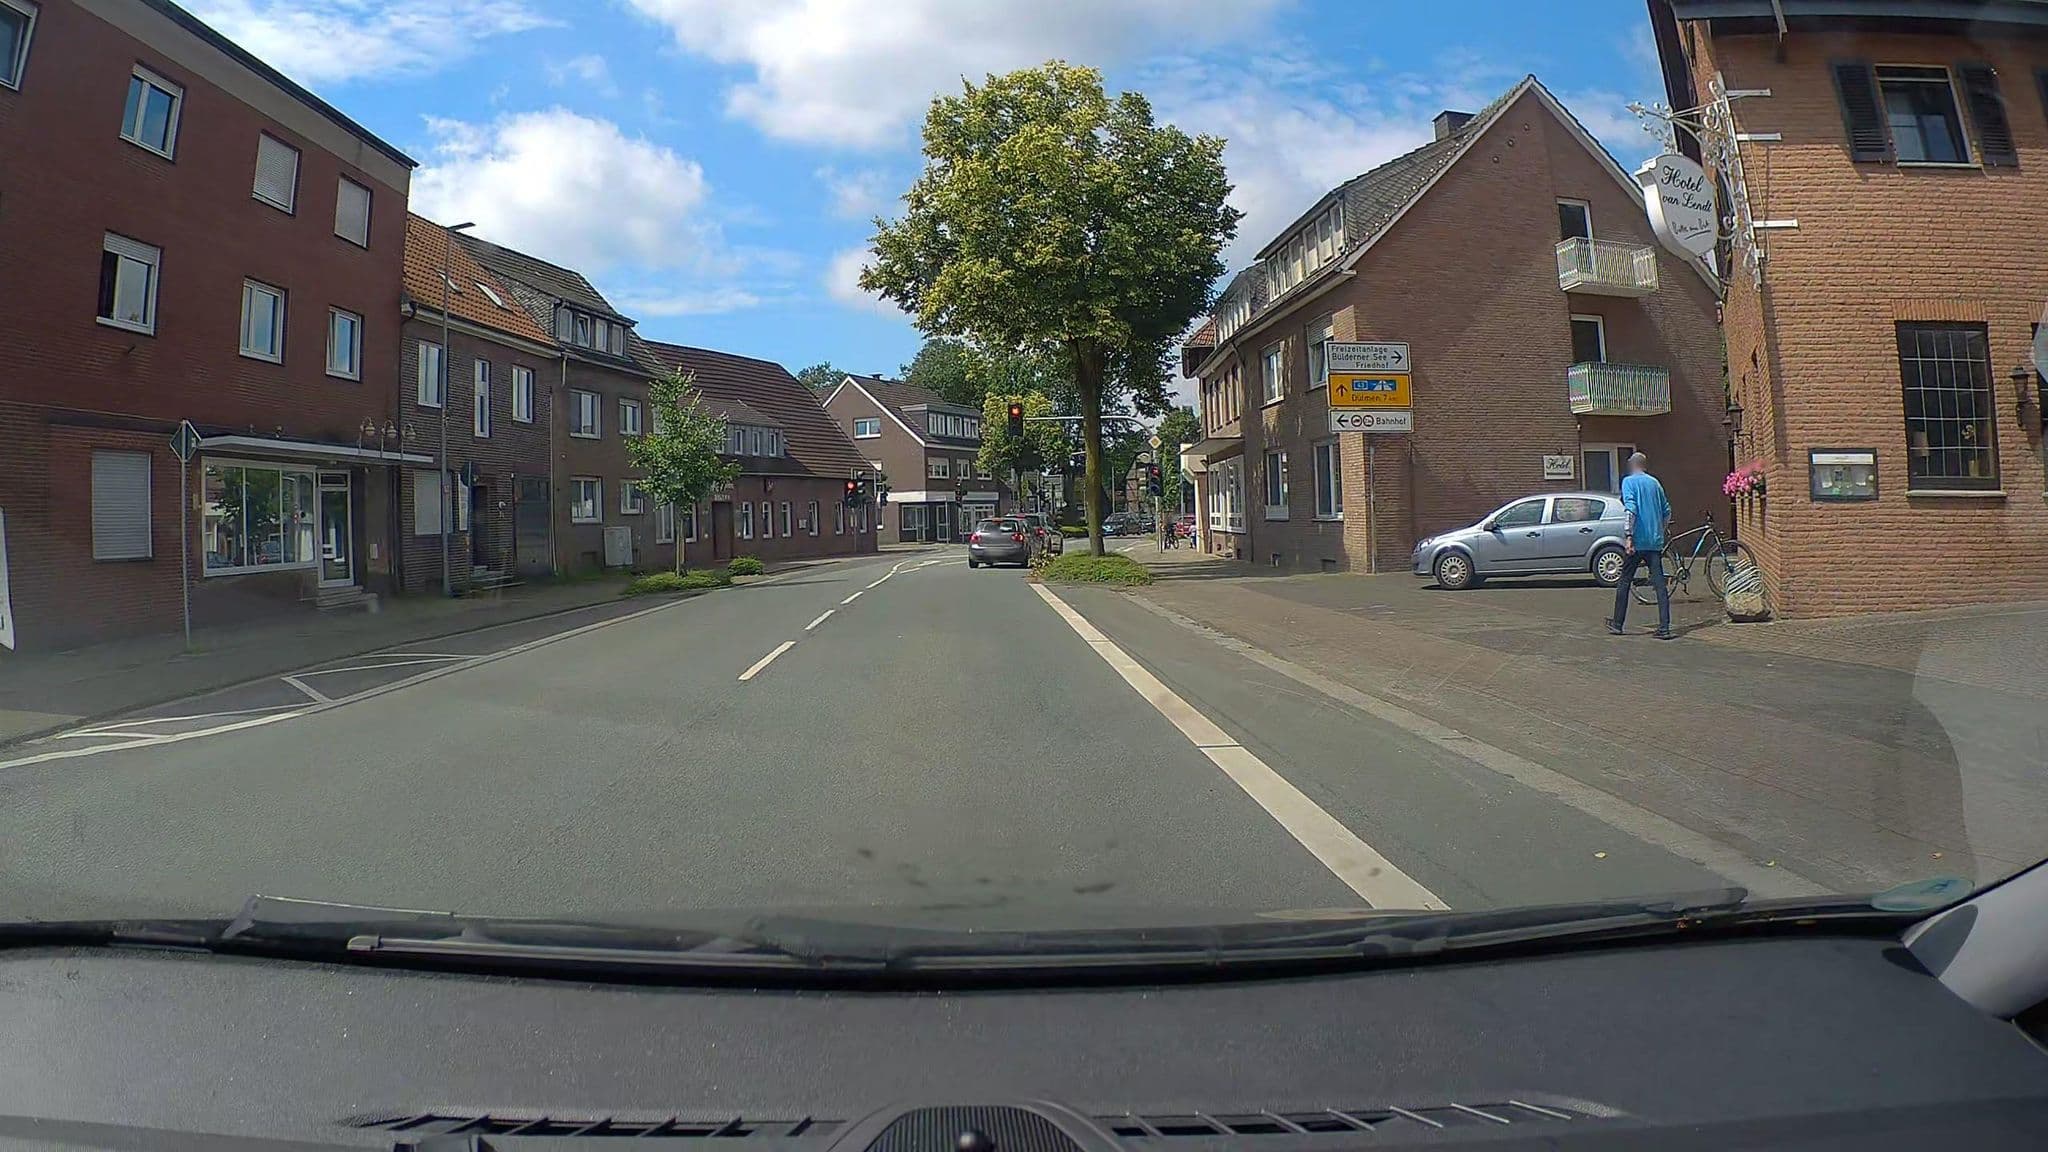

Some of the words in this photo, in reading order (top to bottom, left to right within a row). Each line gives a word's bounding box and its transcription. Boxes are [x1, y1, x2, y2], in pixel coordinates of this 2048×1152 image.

[1661, 165, 1704, 192] Hotel
[1662, 194, 1679, 206] van
[1331, 345, 1388, 354] Freizeitanlage
[1373, 353, 1387, 361] See
[1355, 361, 1389, 369] Friedhof
[1376, 416, 1406, 425] Bahnhof
[1546, 458, 1571, 469] Hotel
